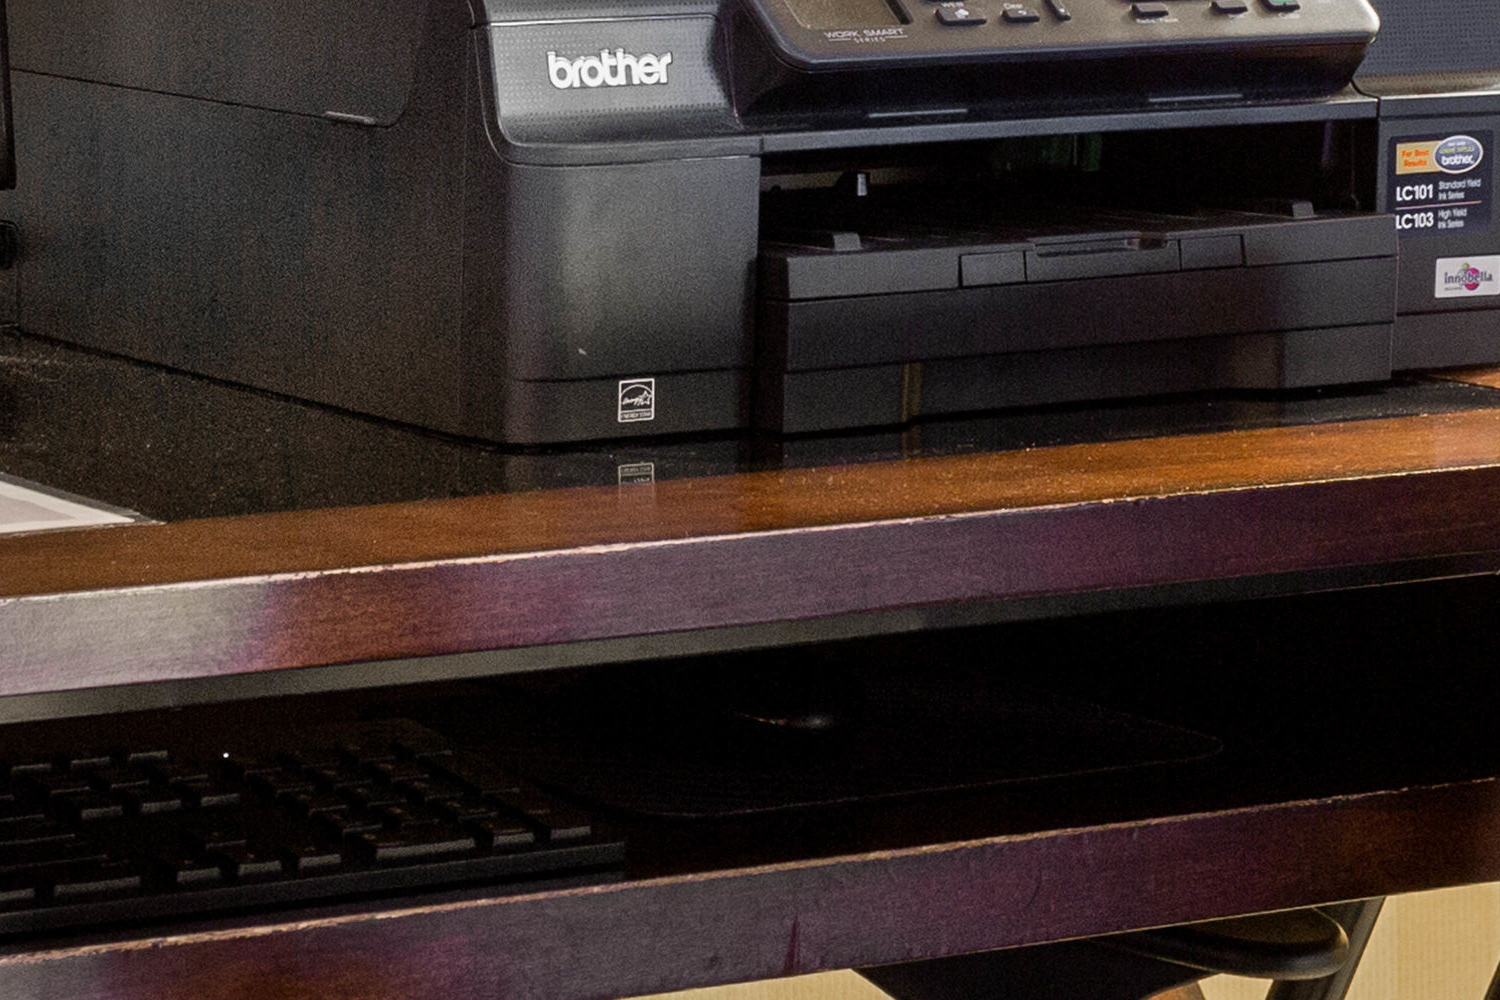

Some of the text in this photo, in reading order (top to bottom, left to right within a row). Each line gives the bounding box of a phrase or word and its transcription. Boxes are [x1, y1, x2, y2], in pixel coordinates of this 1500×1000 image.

[824, 28, 904, 39] WORK SMART
[546, 48, 672, 89] brother
[1414, 149, 1429, 157] Best
[1396, 179, 1481, 201] LC101 Standard Yield
[1438, 191, 1465, 200] Ink Series
[1395, 208, 1467, 229] LC103 High Yield
[1438, 219, 1464, 229] Ink Series
[1444, 271, 1493, 284] innobella
